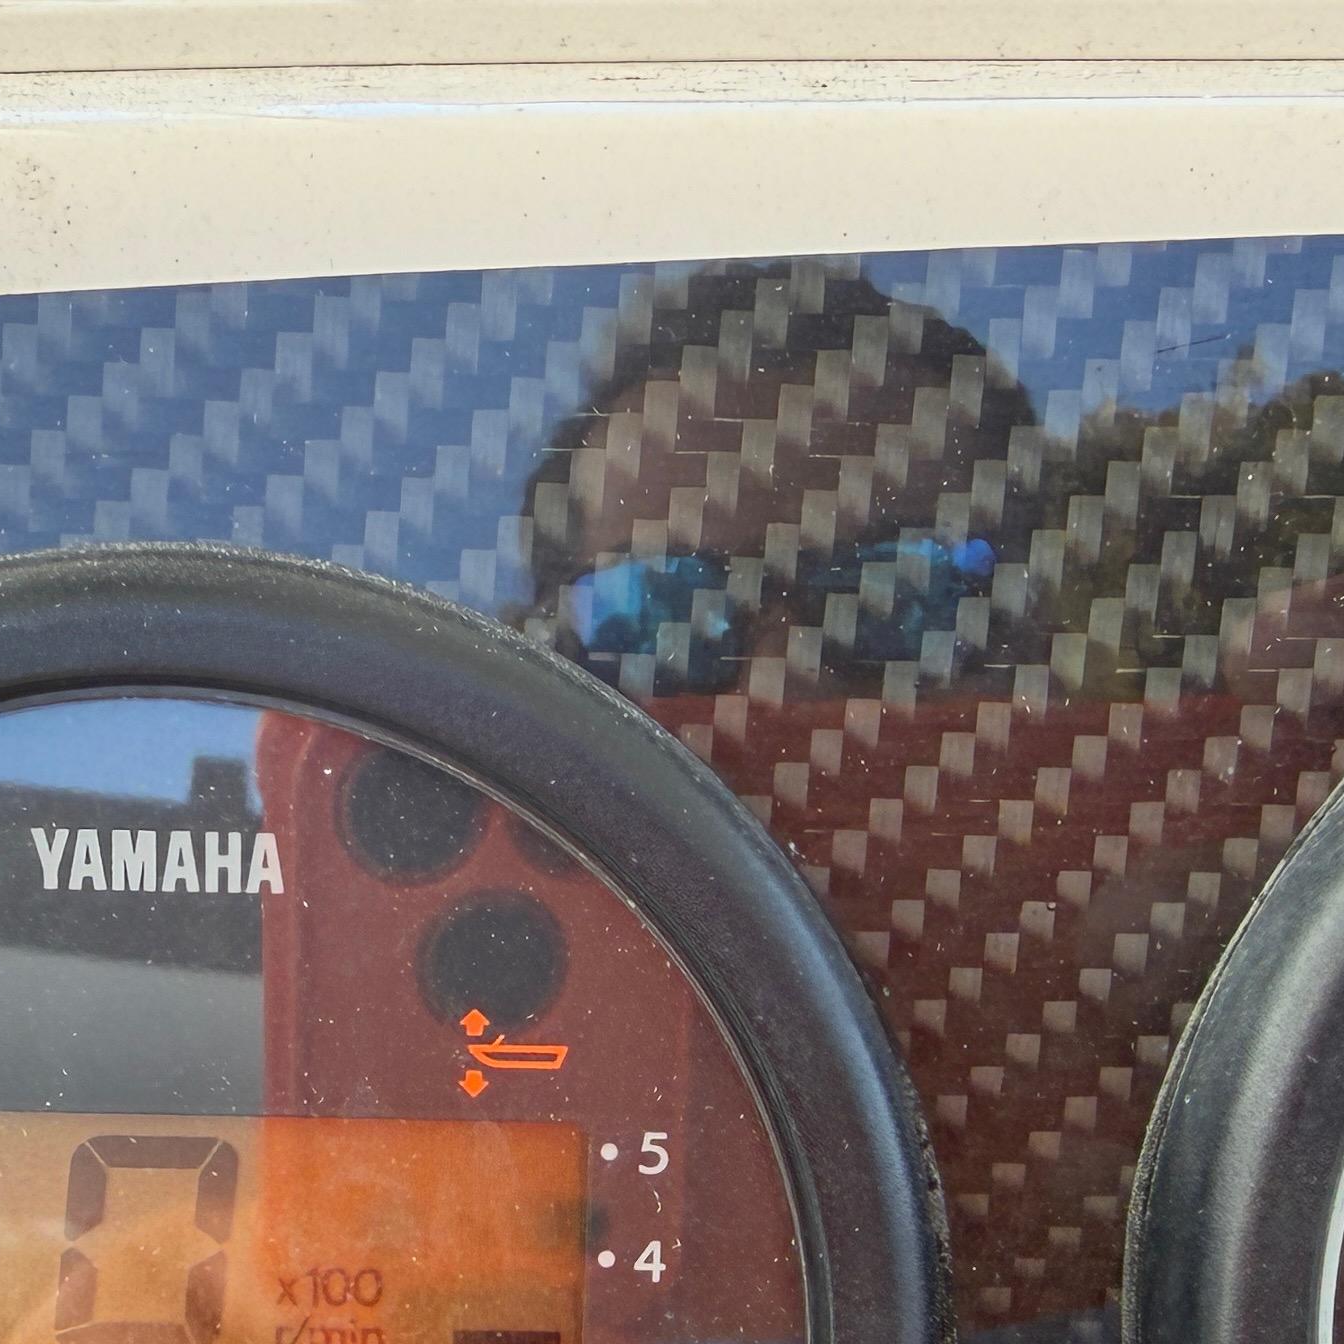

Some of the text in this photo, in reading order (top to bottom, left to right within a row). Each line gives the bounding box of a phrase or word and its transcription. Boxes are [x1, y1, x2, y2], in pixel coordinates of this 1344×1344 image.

[32, 827, 283, 894] YAMAHA
[637, 1132, 671, 1176] 5
[632, 1238, 666, 1284] 4
